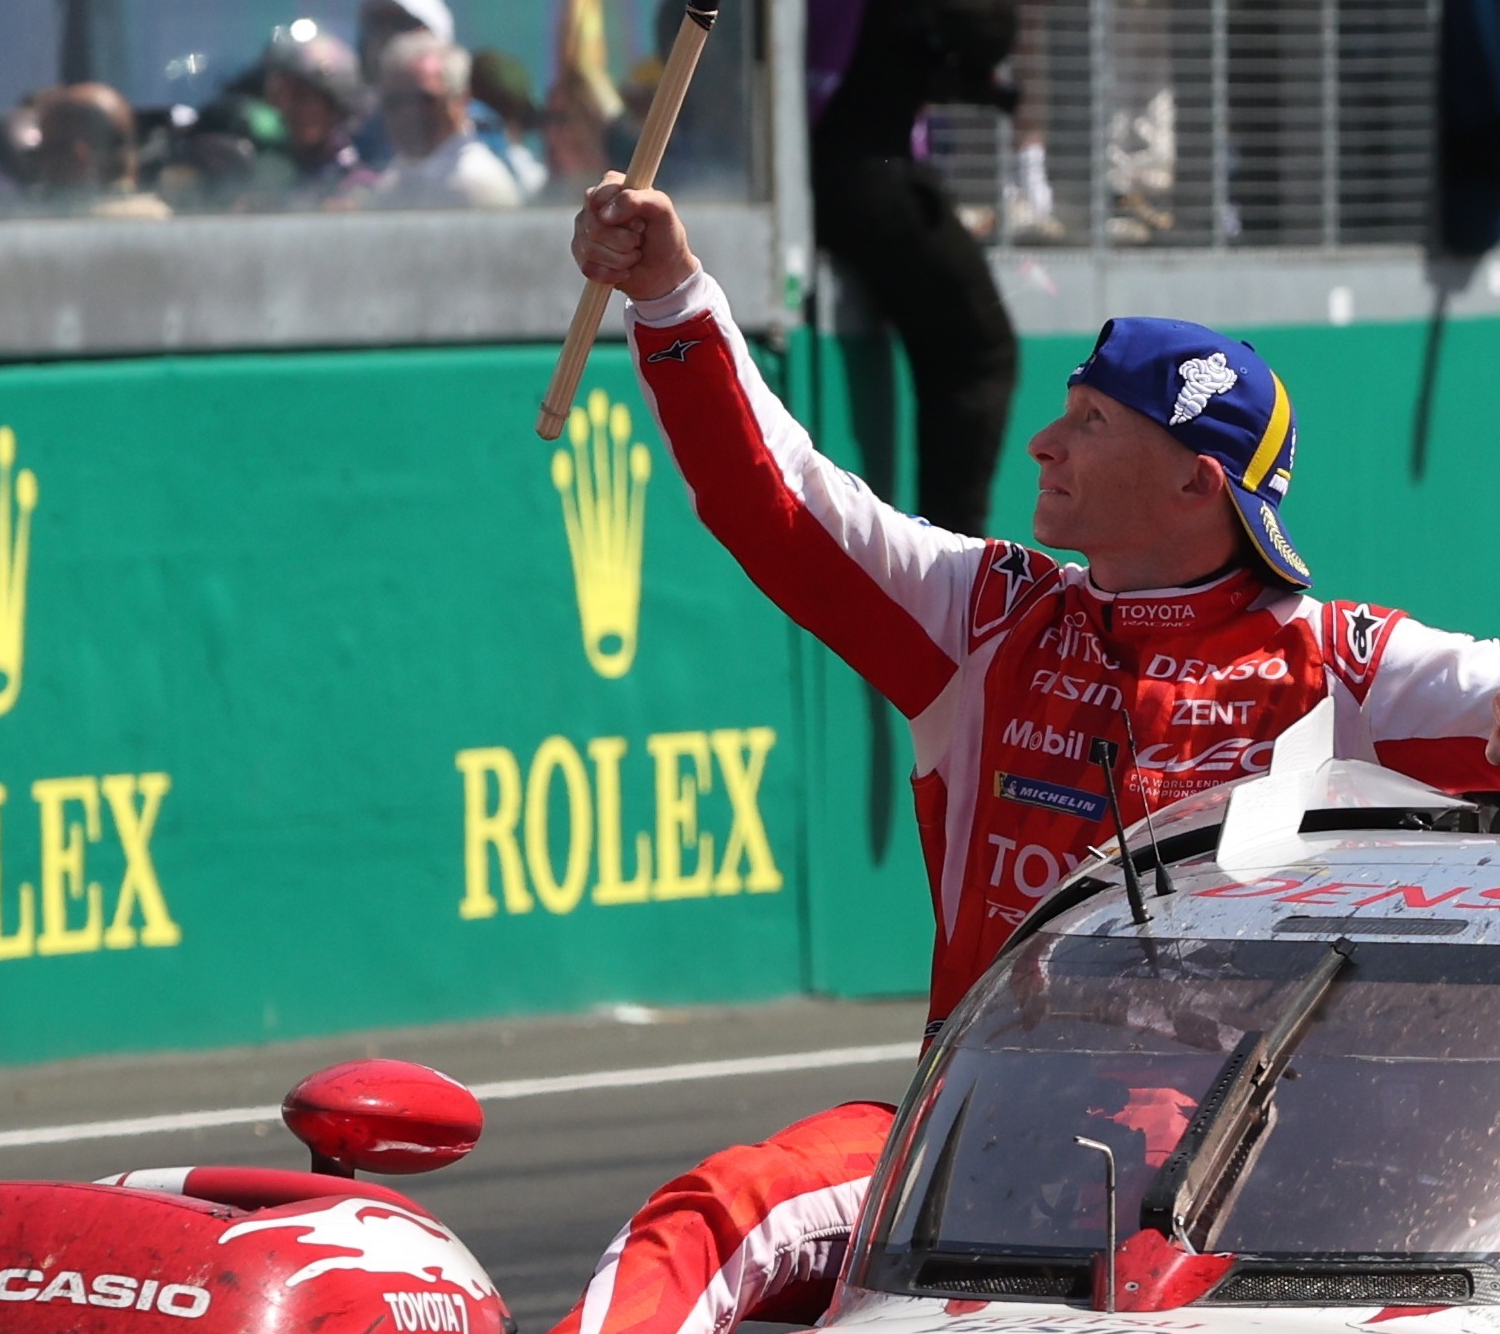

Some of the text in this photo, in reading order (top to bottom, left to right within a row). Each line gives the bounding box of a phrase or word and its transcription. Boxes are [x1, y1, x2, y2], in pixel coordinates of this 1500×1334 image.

[1118, 604, 1195, 620] TOYOTA
[1146, 653, 1291, 684] DENSO
[1171, 699, 1256, 725] ZENT
[1002, 718, 1085, 760] Mobil
[1019, 786, 1096, 812] MICHELIN
[456, 728, 782, 919] ROLEX
[382, 1292, 461, 1332] TOYOTA
